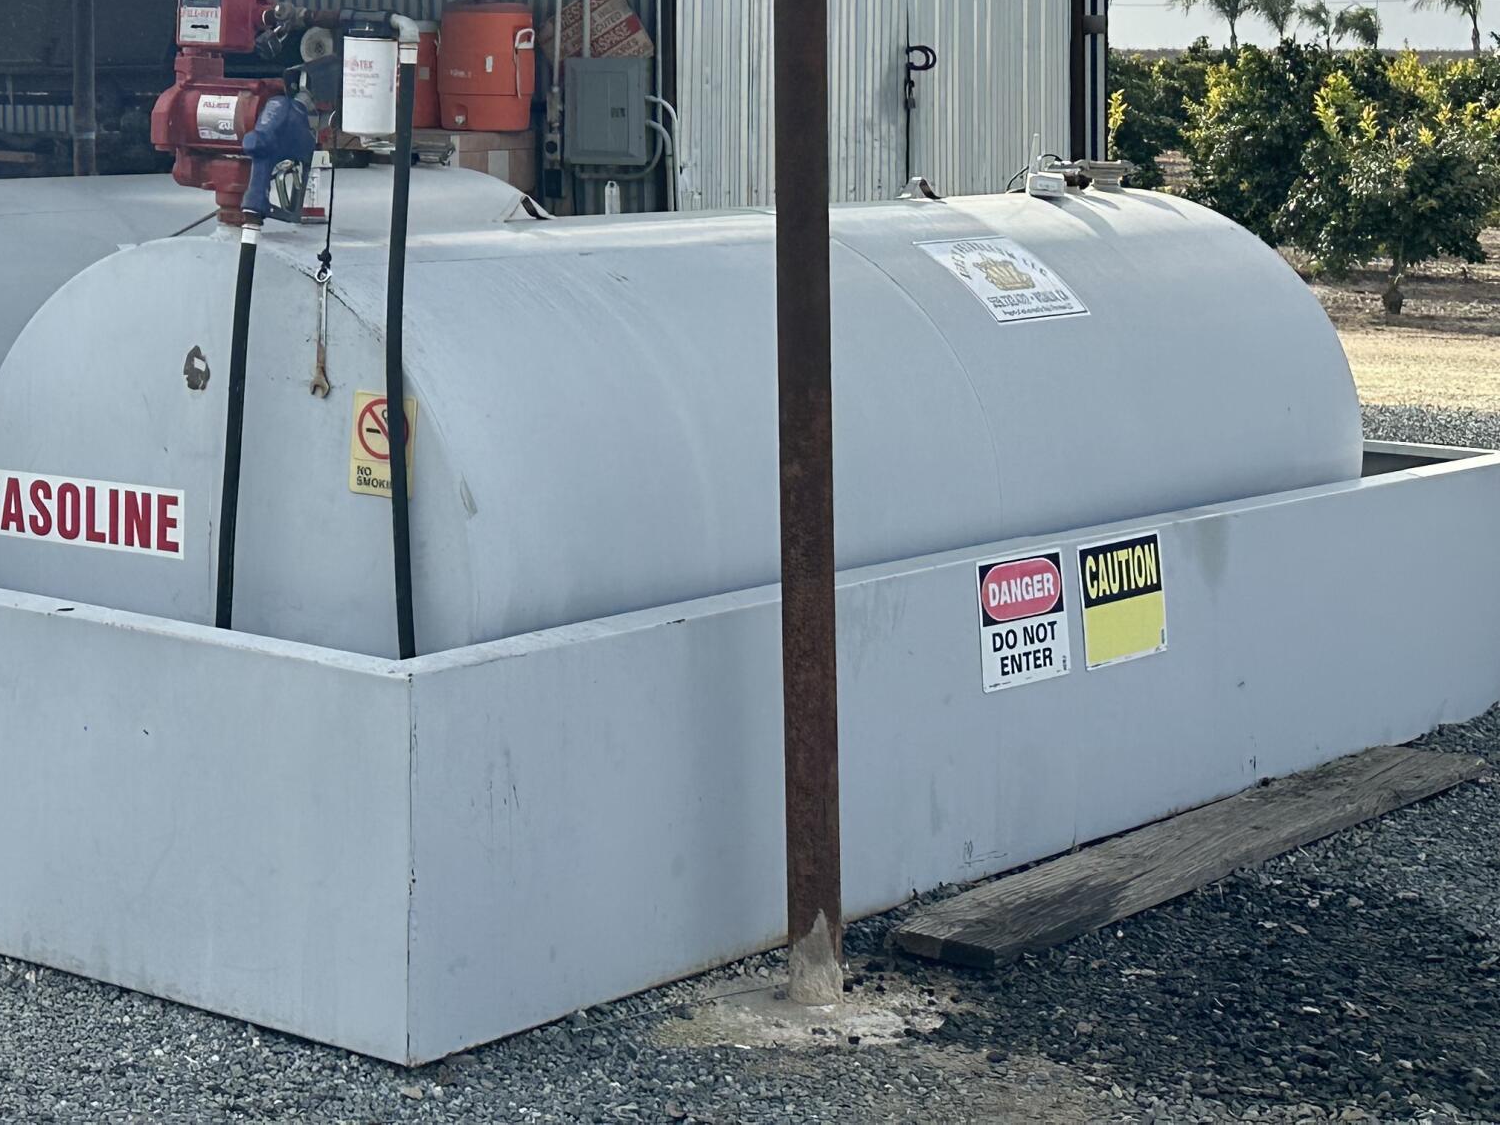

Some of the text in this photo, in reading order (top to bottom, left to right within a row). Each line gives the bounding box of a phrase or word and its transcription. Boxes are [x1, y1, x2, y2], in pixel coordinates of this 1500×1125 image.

[356, 465, 372, 476] NO
[356, 476, 393, 489] SMOKI
[1084, 542, 1158, 600] CAUTION
[988, 572, 1055, 608] DANGER
[992, 620, 1058, 653] DO NOT
[1000, 647, 1053, 677] ENTER
